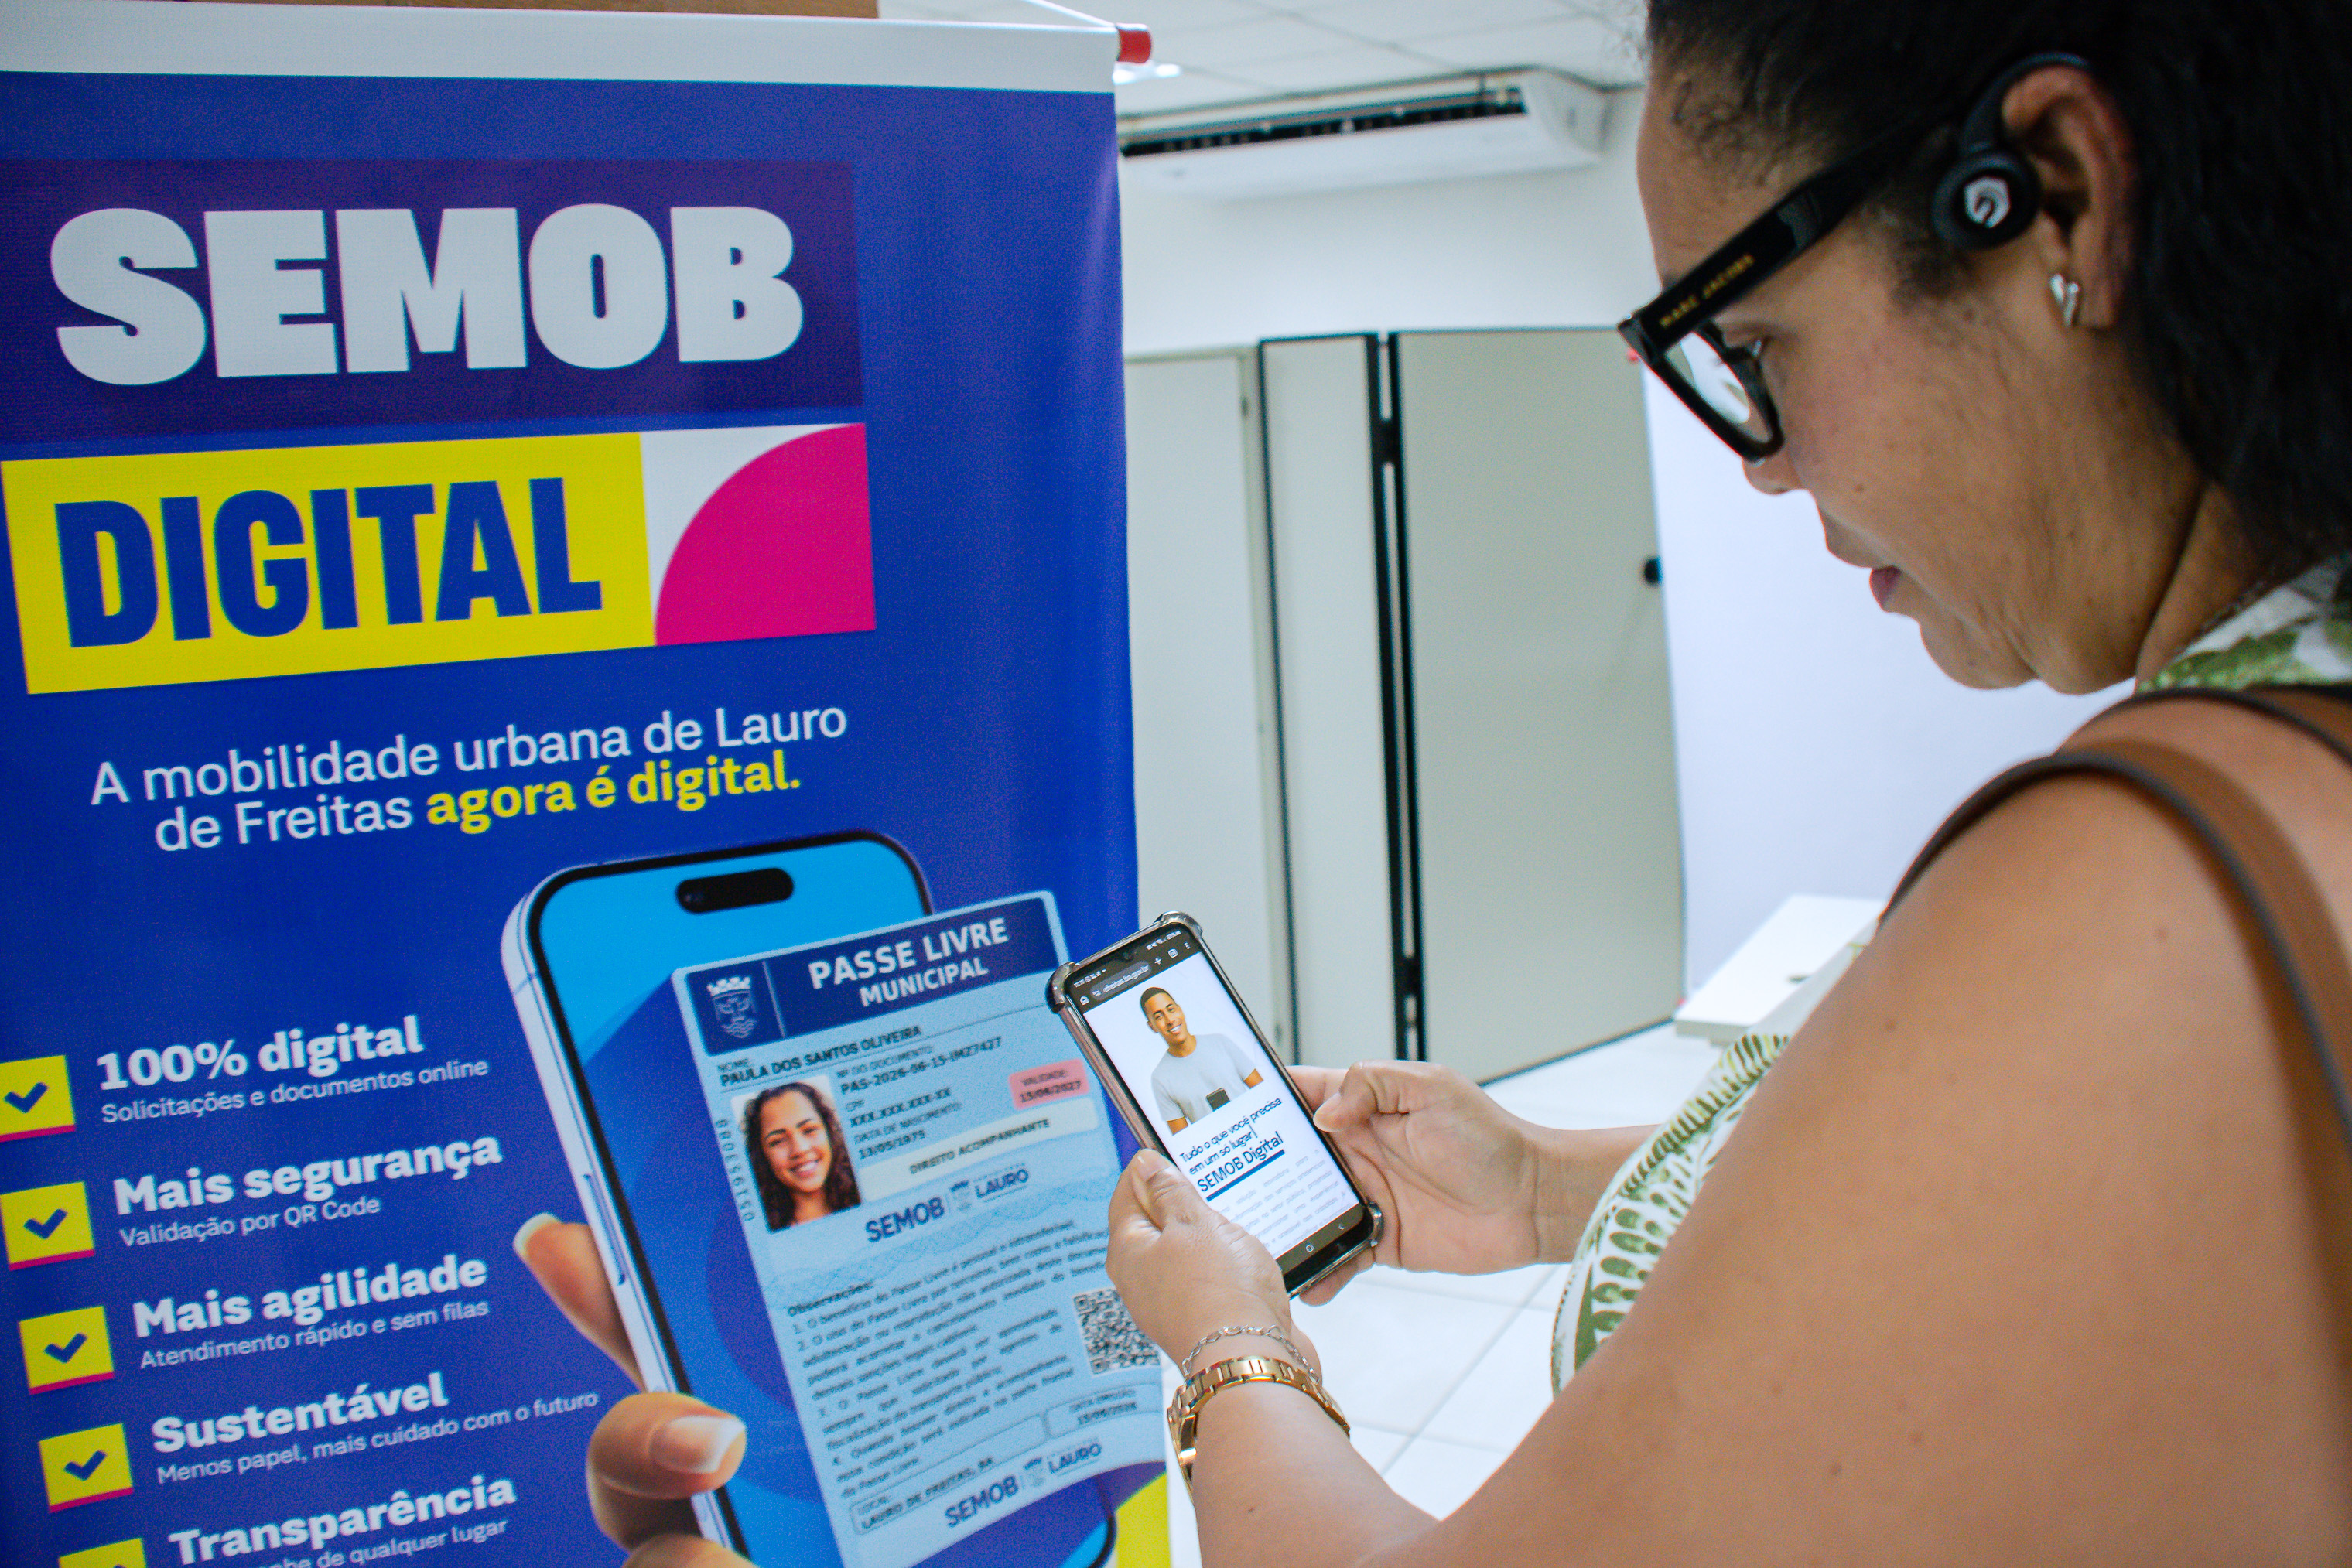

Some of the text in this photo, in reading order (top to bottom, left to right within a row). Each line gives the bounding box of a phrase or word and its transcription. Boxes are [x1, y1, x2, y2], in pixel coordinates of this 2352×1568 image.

[51, 204, 803, 385] SEMOB
[55, 477, 602, 647] DIGITAL
[91, 707, 847, 805] A mobilidade urbana de Lauro
[156, 750, 800, 851] de Freitas agora é digital.
[808, 917, 1008, 991] PASSE LIVRE
[859, 957, 988, 1007] MUNICIPAL
[96, 1014, 424, 1090] 100% digital
[720, 1026, 921, 1086] PAULA DOS SANTOS OLIVEIRA
[101, 1060, 489, 1123] Solicitações e documentos online
[1180, 1146, 1203, 1162] Tudo
[1211, 1130, 1228, 1145] que
[1228, 1116, 1250, 1133] você
[1250, 1098, 1282, 1123] precisa
[1189, 1162, 1205, 1174] em
[1204, 1153, 1219, 1166] um
[1219, 1144, 1231, 1156] só
[1198, 1131, 1284, 1192] SEMOB Digital
[114, 1136, 503, 1214] Mais segurança
[865, 1197, 945, 1243] SEMOB
[974, 1168, 1030, 1199] LAURO
[120, 1196, 381, 1247] Validação por QR Code
[132, 1253, 487, 1338] Mais agilidade
[140, 1300, 489, 1369] Atendimento rápido e sem filas
[152, 1370, 449, 1453] Sustentável
[156, 1391, 598, 1484] Menos papel, mais cuidado com o futuro
[169, 1474, 518, 1565] Transparência
[945, 1475, 1020, 1527] SEMOB
[1048, 1442, 1102, 1474] LAURO
[317, 1546, 344, 1568] de
[349, 1530, 447, 1564] qualquer
[452, 1518, 508, 1545] lugar
